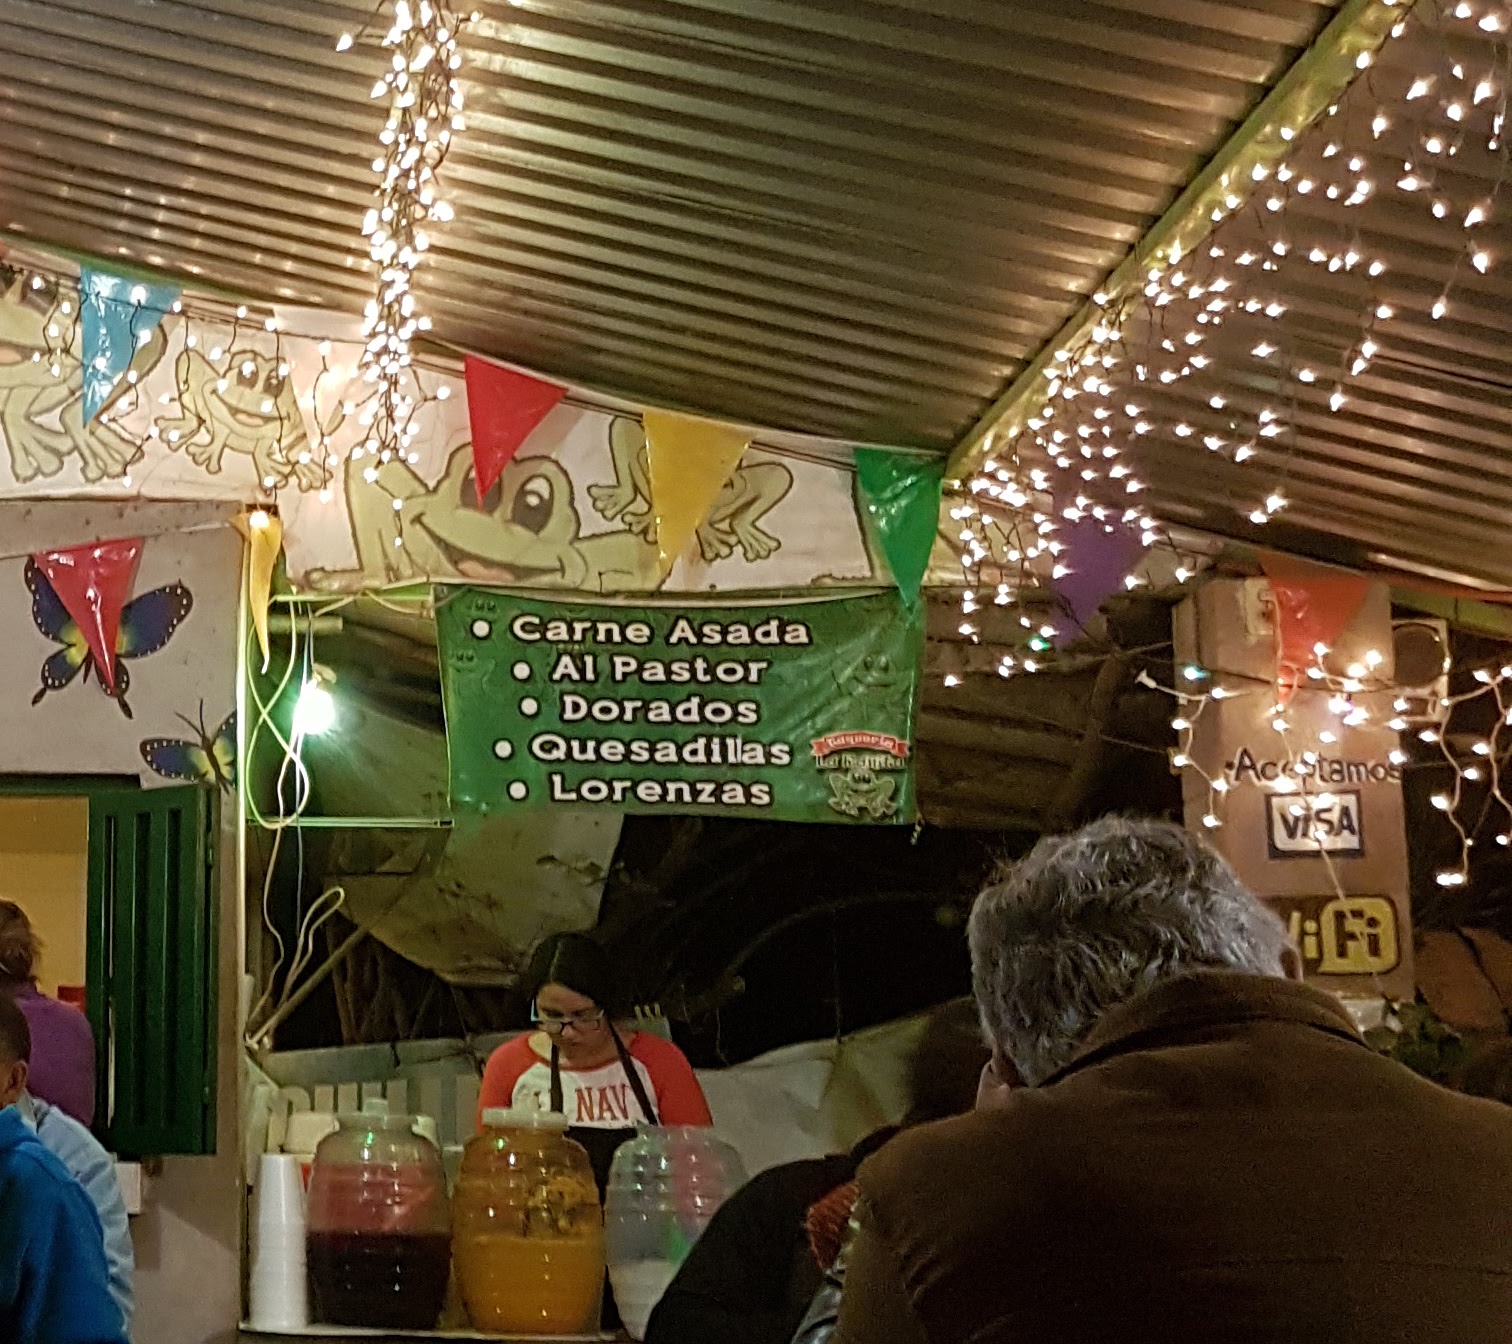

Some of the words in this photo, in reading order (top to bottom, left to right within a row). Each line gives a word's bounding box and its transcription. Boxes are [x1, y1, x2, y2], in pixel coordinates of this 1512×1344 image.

[511, 614, 651, 645] Carne
[669, 616, 812, 646] Asada
[552, 655, 595, 683] Al
[614, 655, 769, 684] Pastor
[561, 694, 760, 725] Dorados
[530, 732, 792, 766] Quesadillas
[551, 774, 772, 807] Lorenzas
[1279, 803, 1357, 840] VISA
[1289, 908, 1382, 960] iFi
